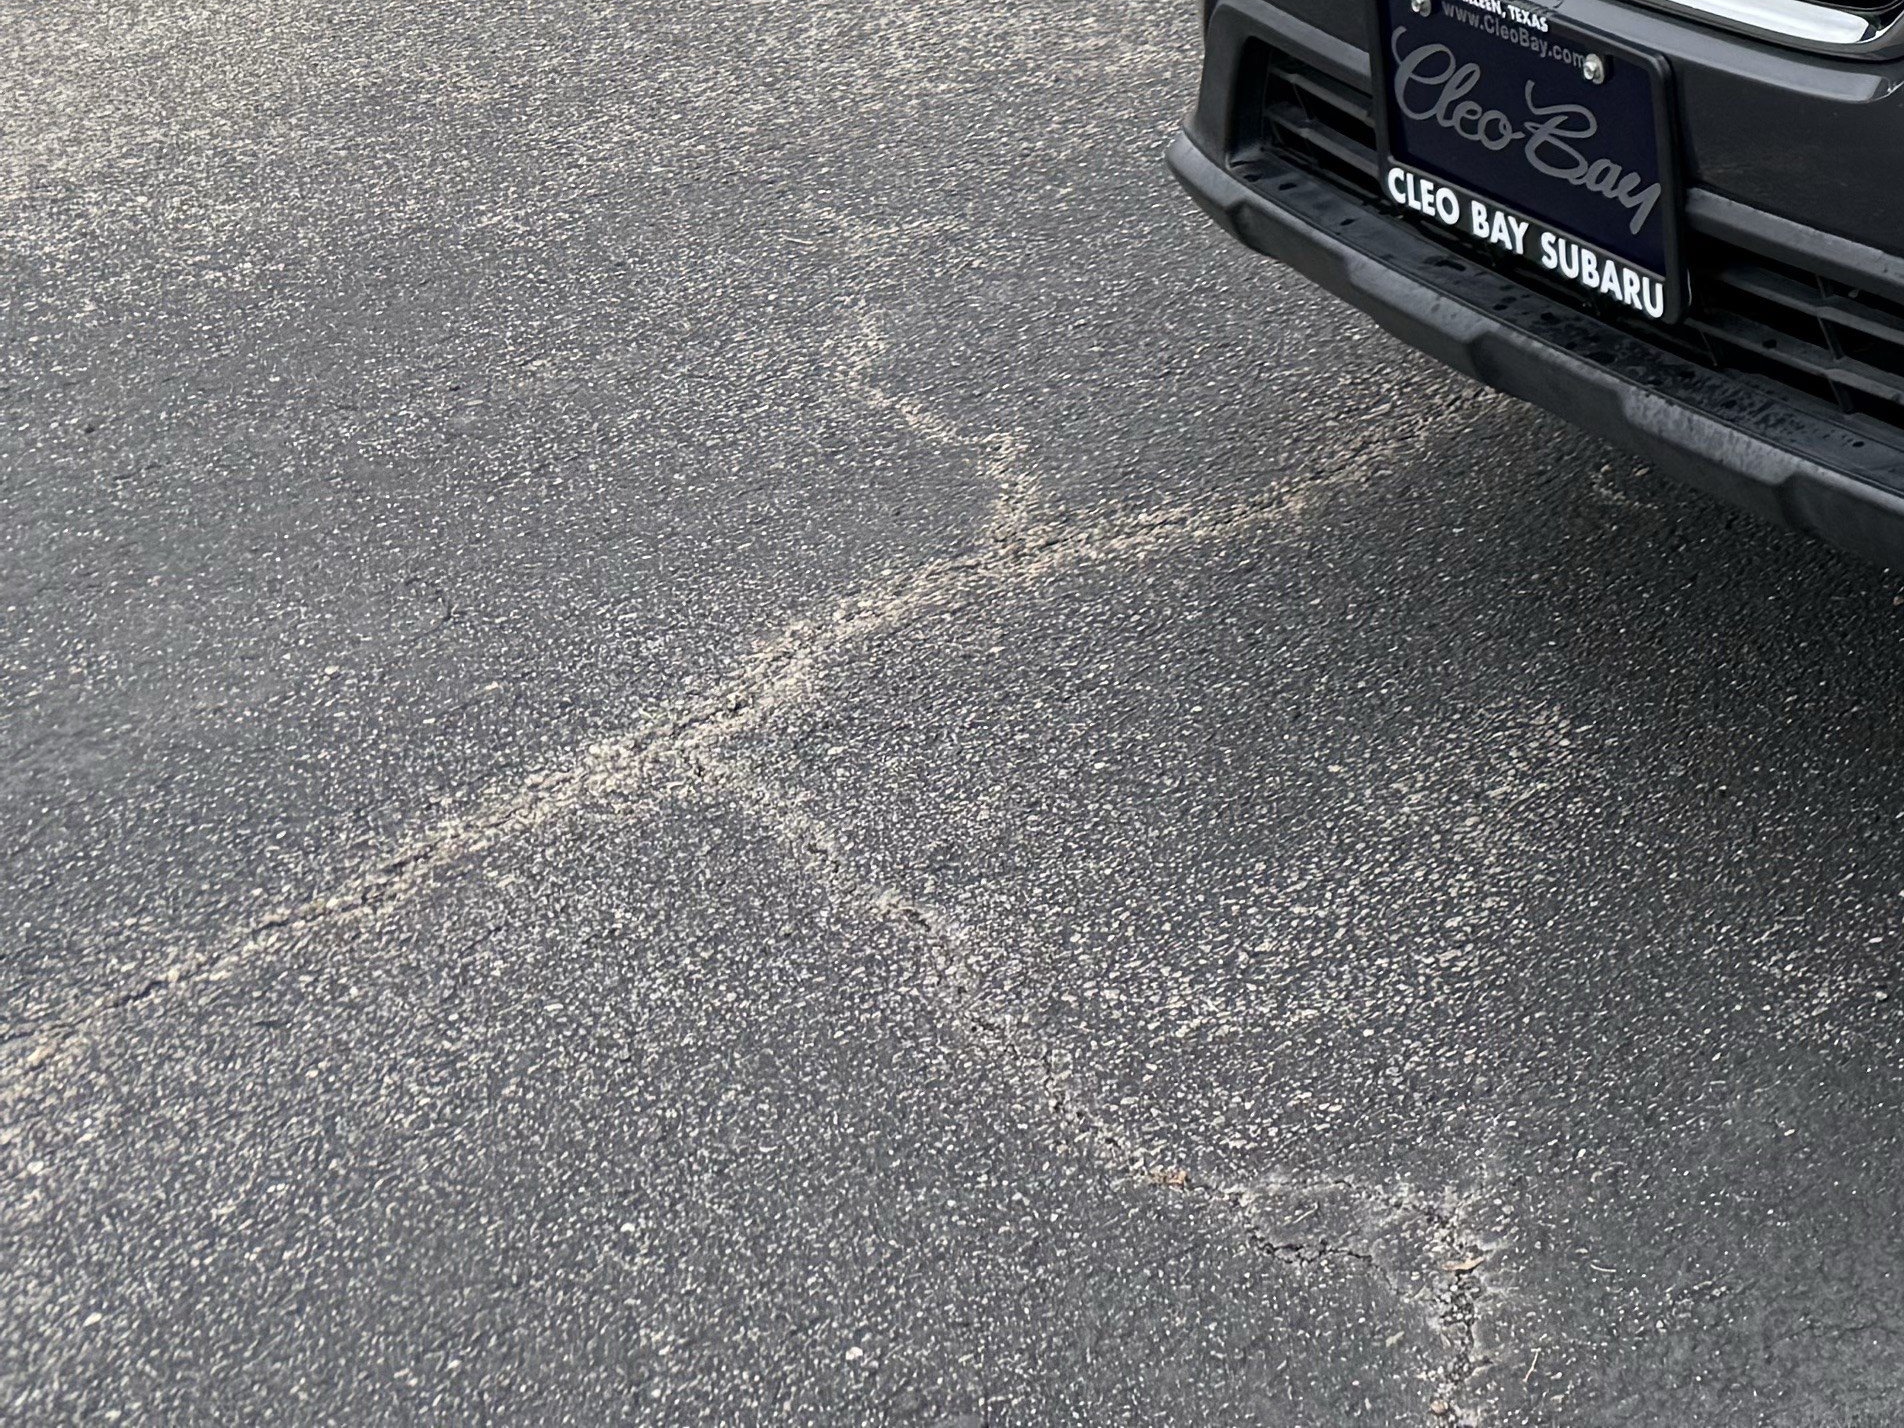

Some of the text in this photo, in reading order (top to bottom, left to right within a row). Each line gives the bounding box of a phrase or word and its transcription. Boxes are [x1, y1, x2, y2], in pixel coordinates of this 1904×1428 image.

[1441, 0, 1585, 69] www.CleoBay.com
[1508, 4, 1548, 33] TEXAS
[1392, 25, 1661, 235] Cleo Bay
[1387, 167, 1665, 319] CLEO BAY SUBARU
